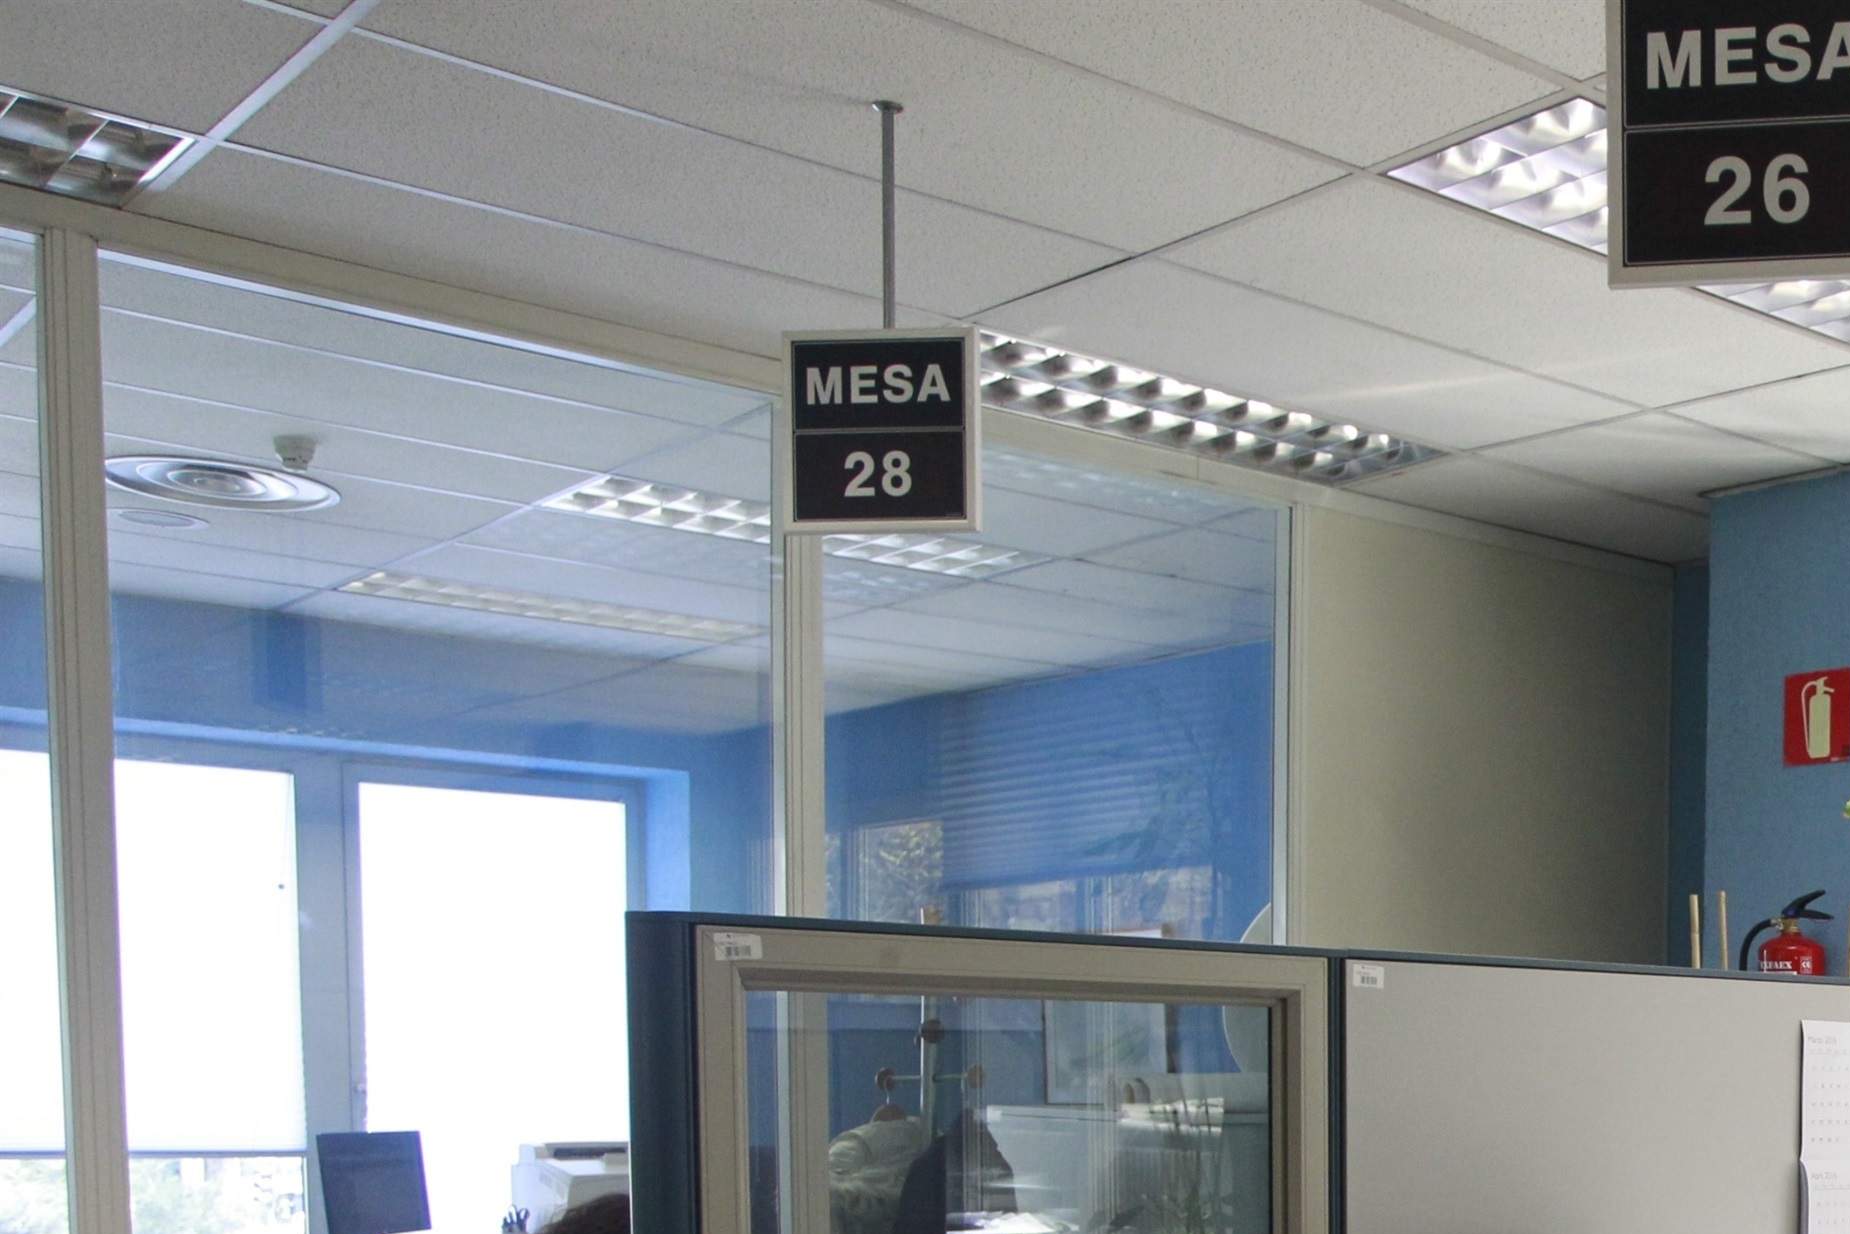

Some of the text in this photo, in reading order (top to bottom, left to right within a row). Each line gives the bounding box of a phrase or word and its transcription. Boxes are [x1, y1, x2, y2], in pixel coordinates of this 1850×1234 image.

[1703, 152, 1811, 226] 26
[806, 362, 951, 406] MESA
[844, 449, 913, 498] 28
